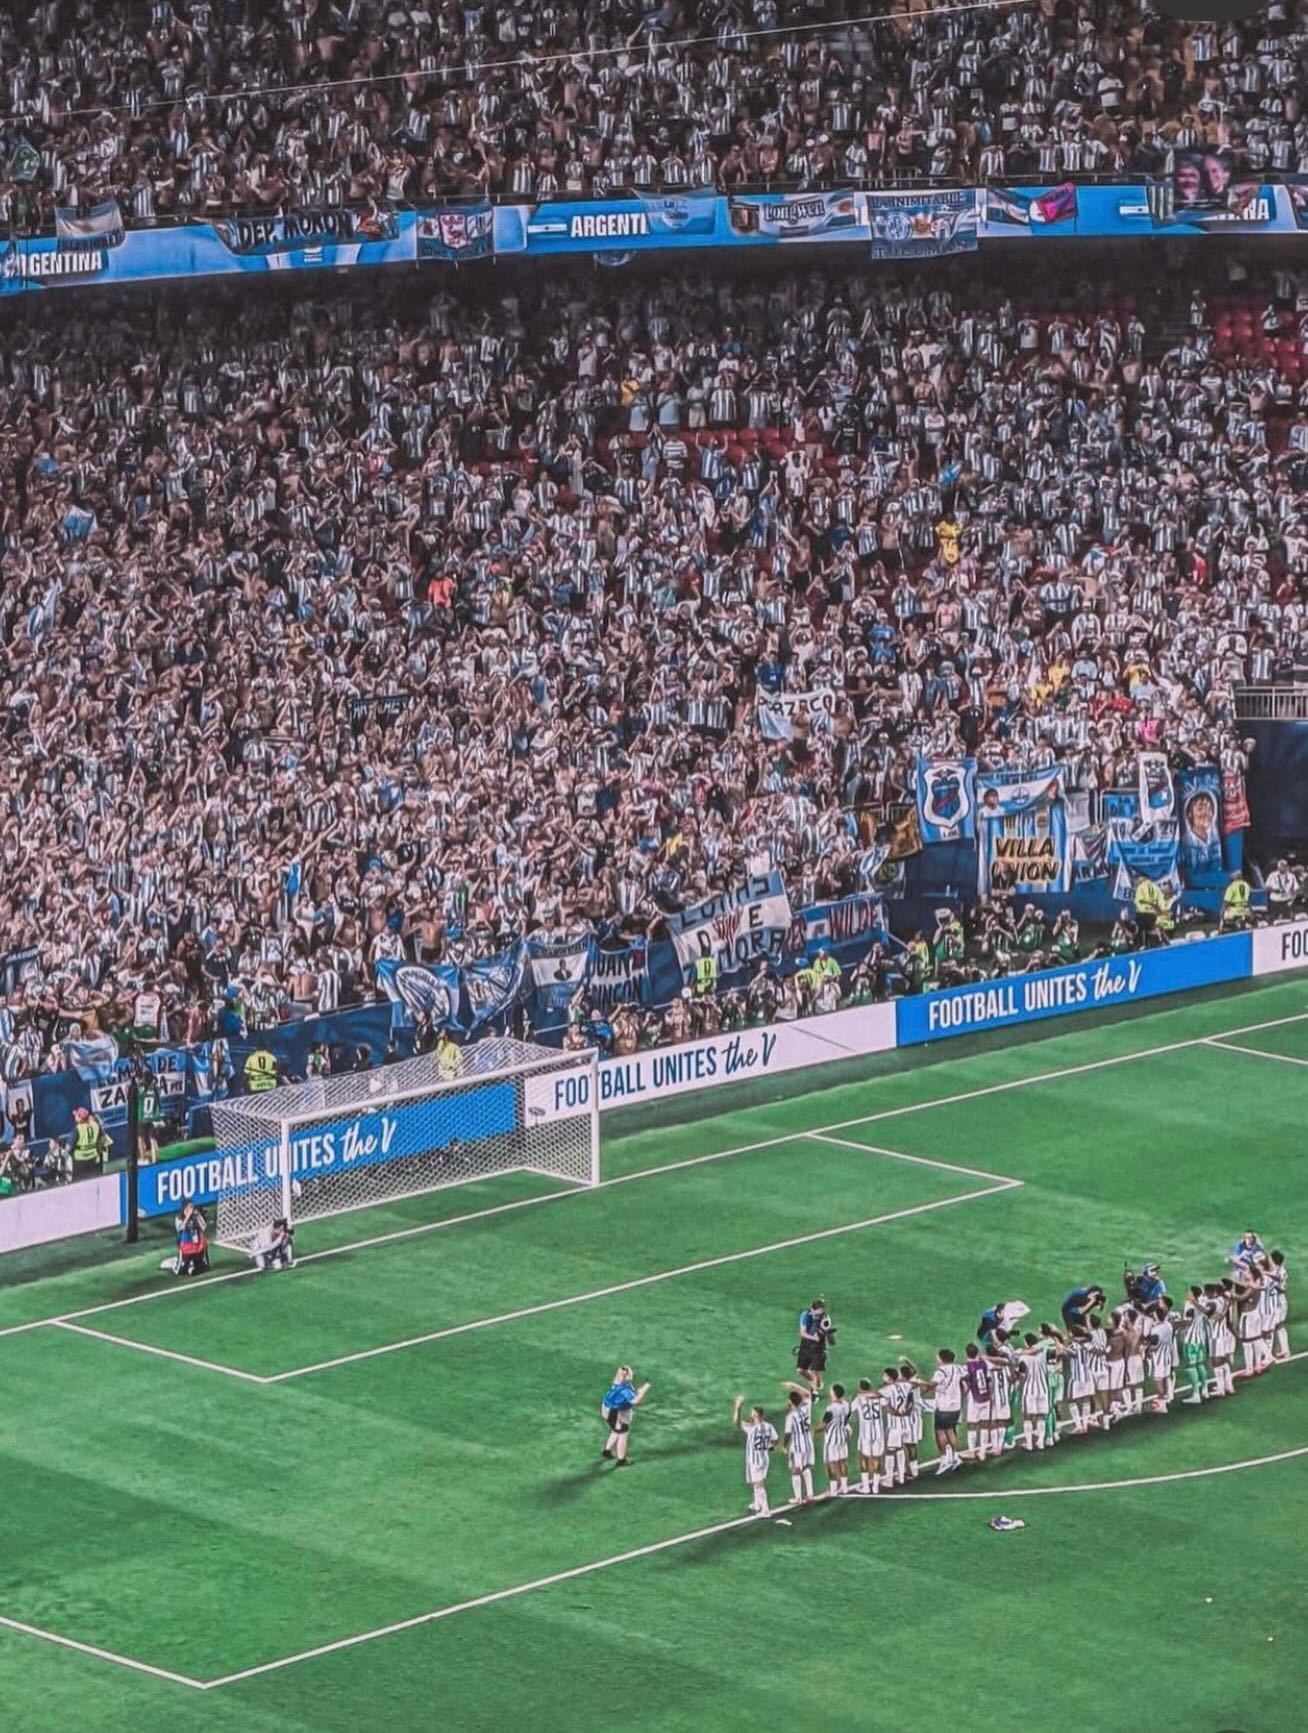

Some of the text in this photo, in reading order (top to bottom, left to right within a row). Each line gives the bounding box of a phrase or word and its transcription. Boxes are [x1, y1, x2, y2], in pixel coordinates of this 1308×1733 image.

[571, 212, 649, 238] ARGENTI
[996, 837, 1056, 857] VILLA
[929, 960, 1142, 1032] FOOTBALL UNITES the V
[158, 1055, 177, 1073] DE
[555, 1032, 777, 1111] FOOBALL UNITES the V
[157, 1116, 397, 1205] FOOTBALL UITES the V
[861, 1402, 880, 1420] 25
